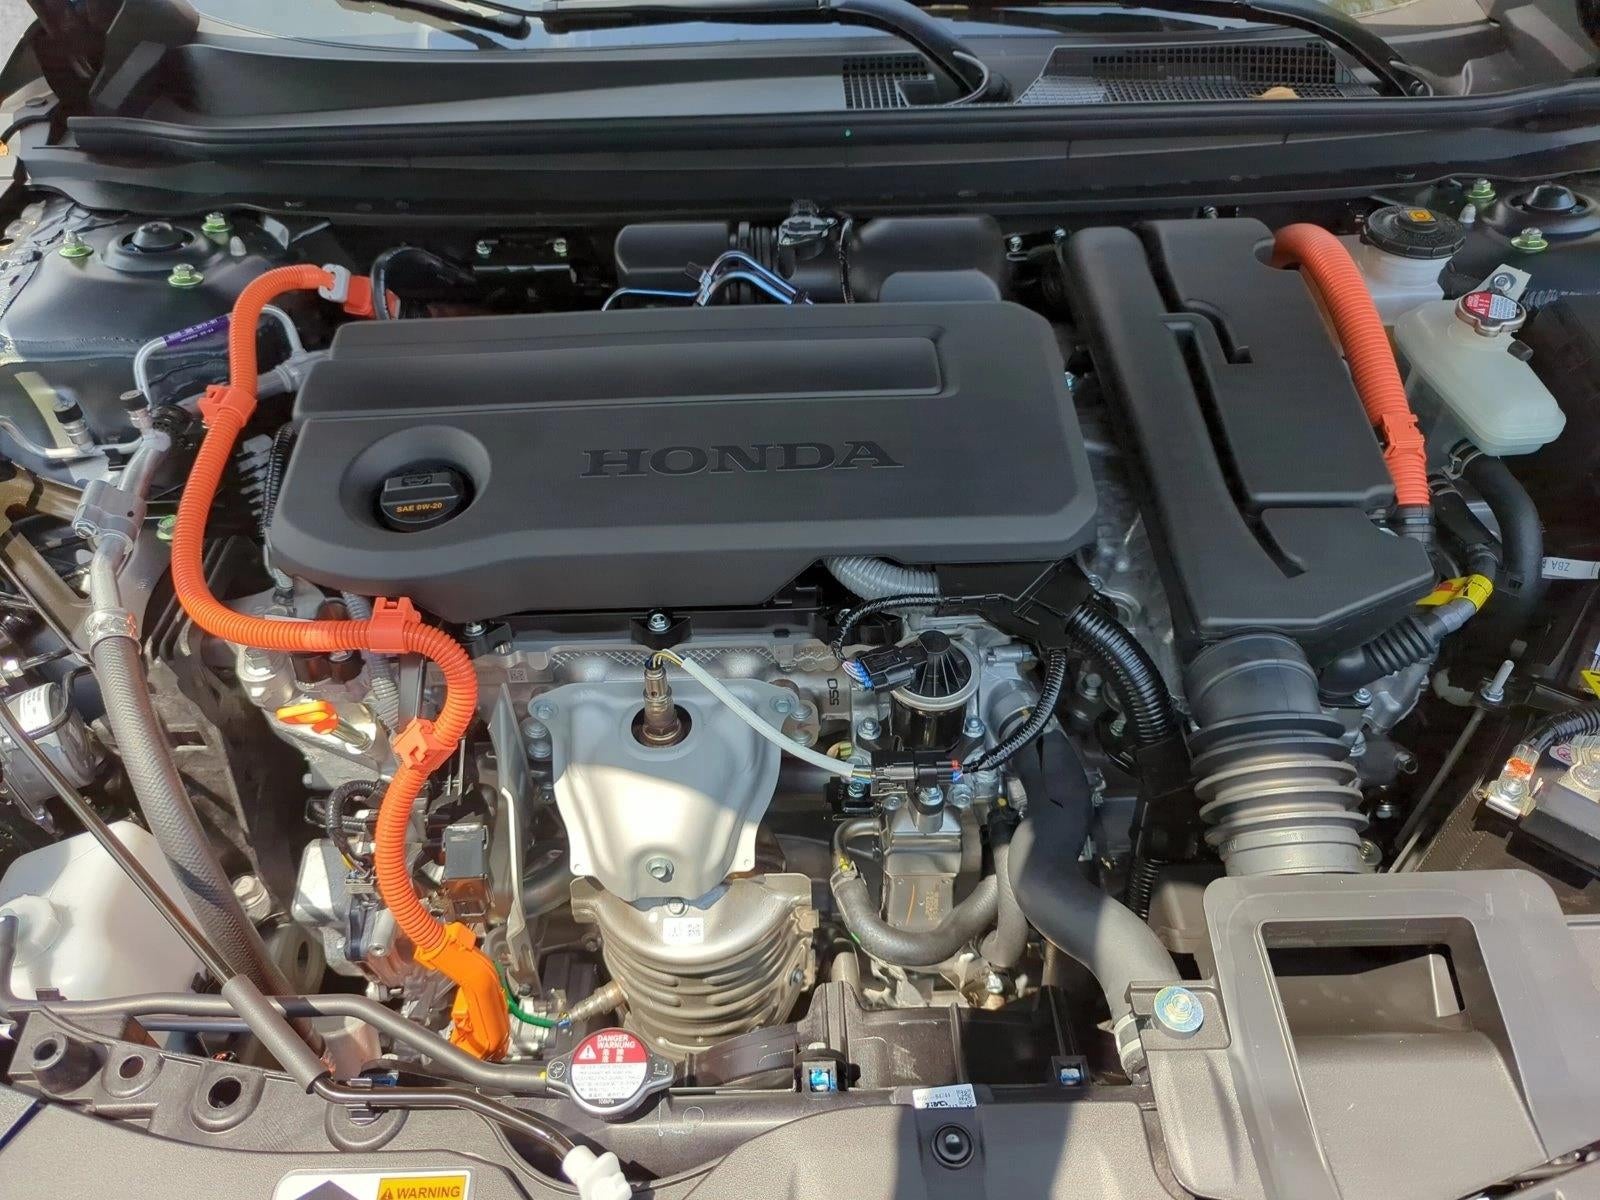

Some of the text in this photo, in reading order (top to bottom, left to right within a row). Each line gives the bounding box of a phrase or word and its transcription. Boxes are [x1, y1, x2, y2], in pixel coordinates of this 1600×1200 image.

[580, 440, 905, 478] HONDA
[396, 503, 442, 513] SAE 0W-20
[597, 1041, 636, 1049] WARNUNG
[397, 1186, 461, 1199] WARNING
